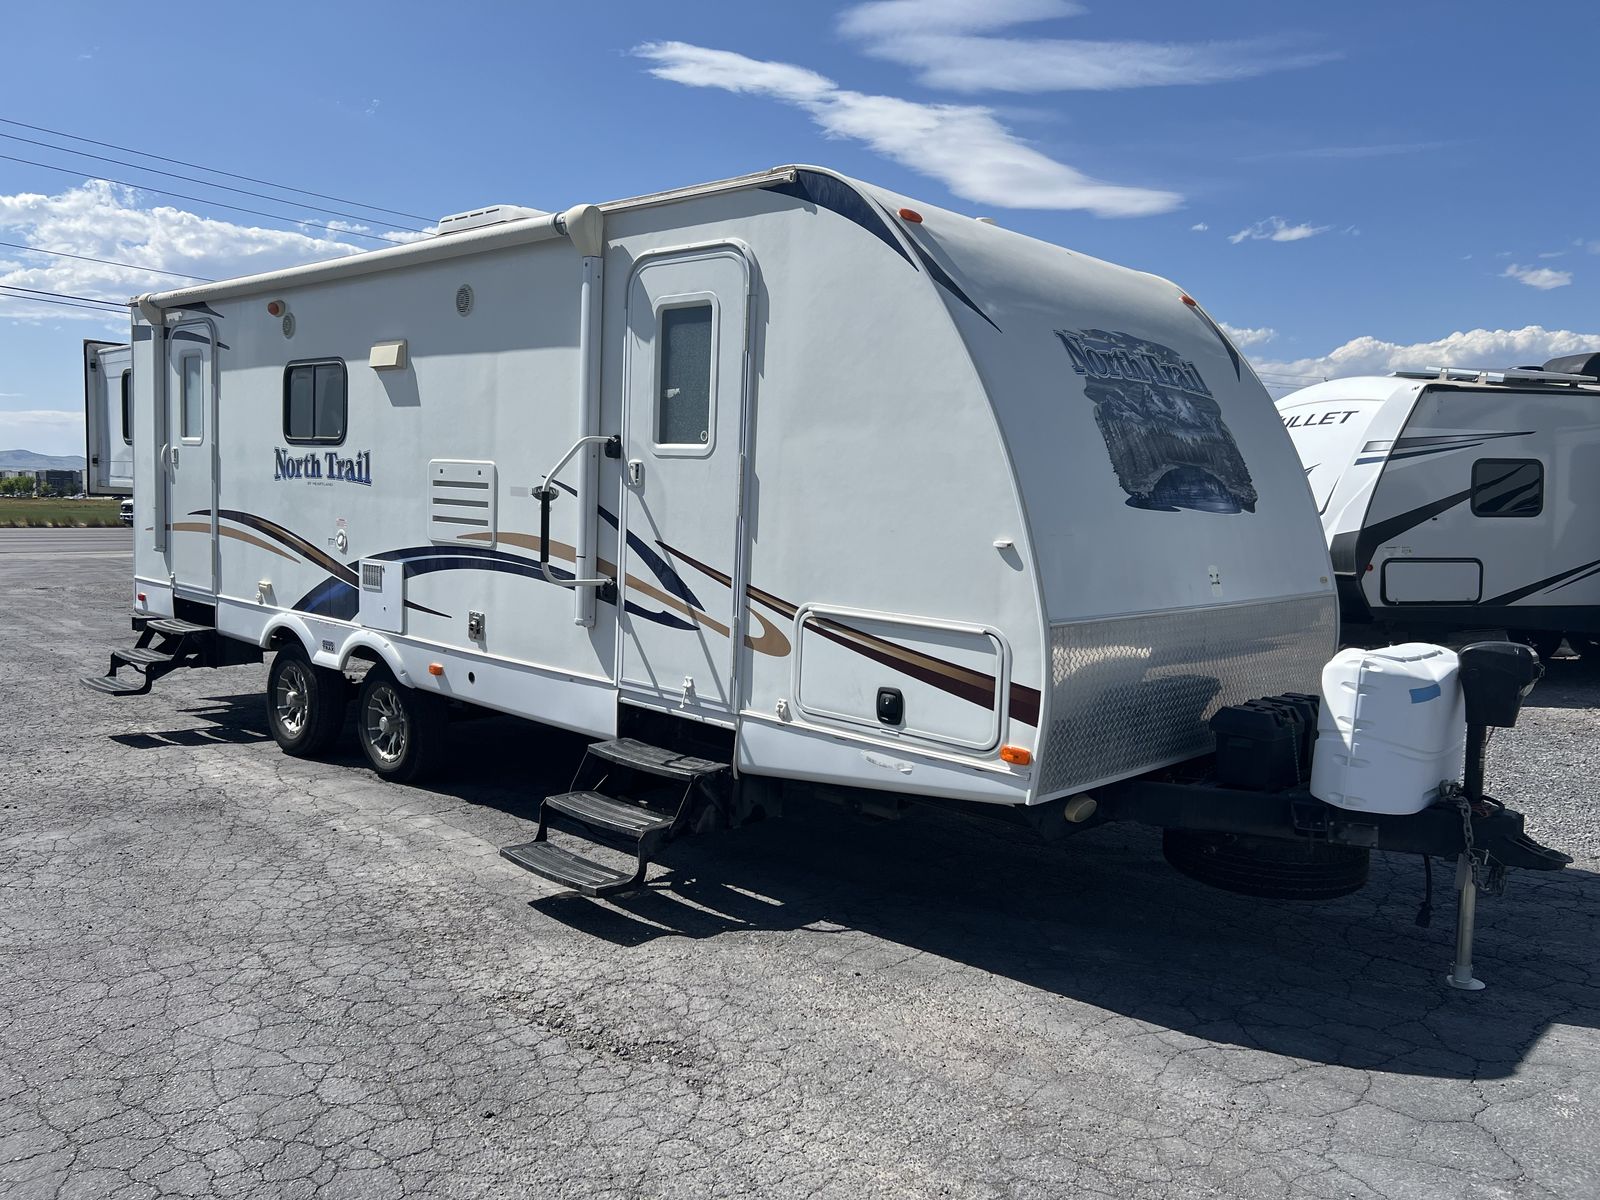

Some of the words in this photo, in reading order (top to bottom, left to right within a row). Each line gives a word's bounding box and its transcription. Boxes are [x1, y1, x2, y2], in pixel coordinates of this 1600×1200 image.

[1053, 329, 1152, 384] North
[1140, 350, 1214, 399] Trail
[1281, 410, 1360, 428] ULLET
[274, 447, 322, 481] North
[324, 450, 372, 487] Trail
